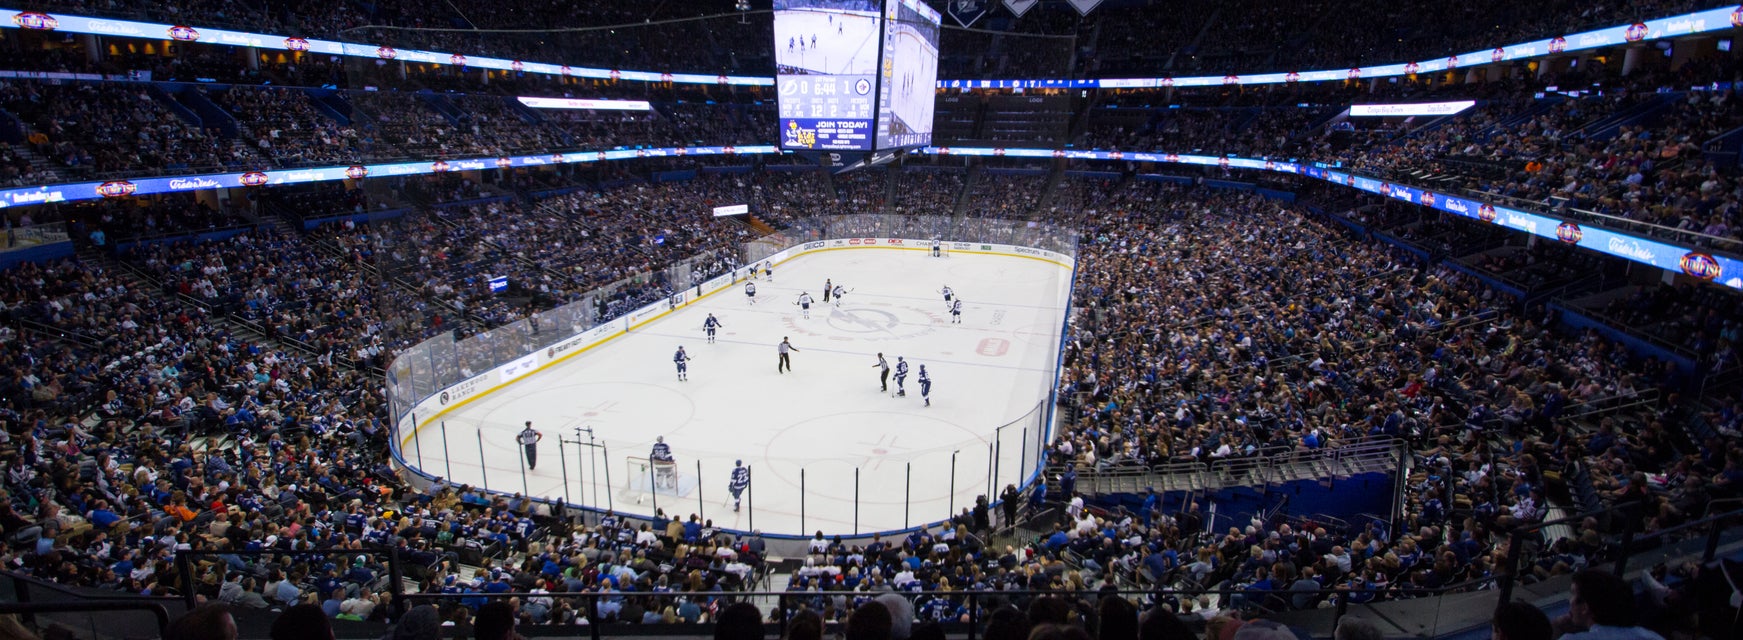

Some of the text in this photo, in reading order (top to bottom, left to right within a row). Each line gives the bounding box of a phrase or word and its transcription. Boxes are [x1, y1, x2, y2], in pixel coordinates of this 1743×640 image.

[814, 83, 836, 95] 6:44
[811, 105, 837, 117] 12 2
